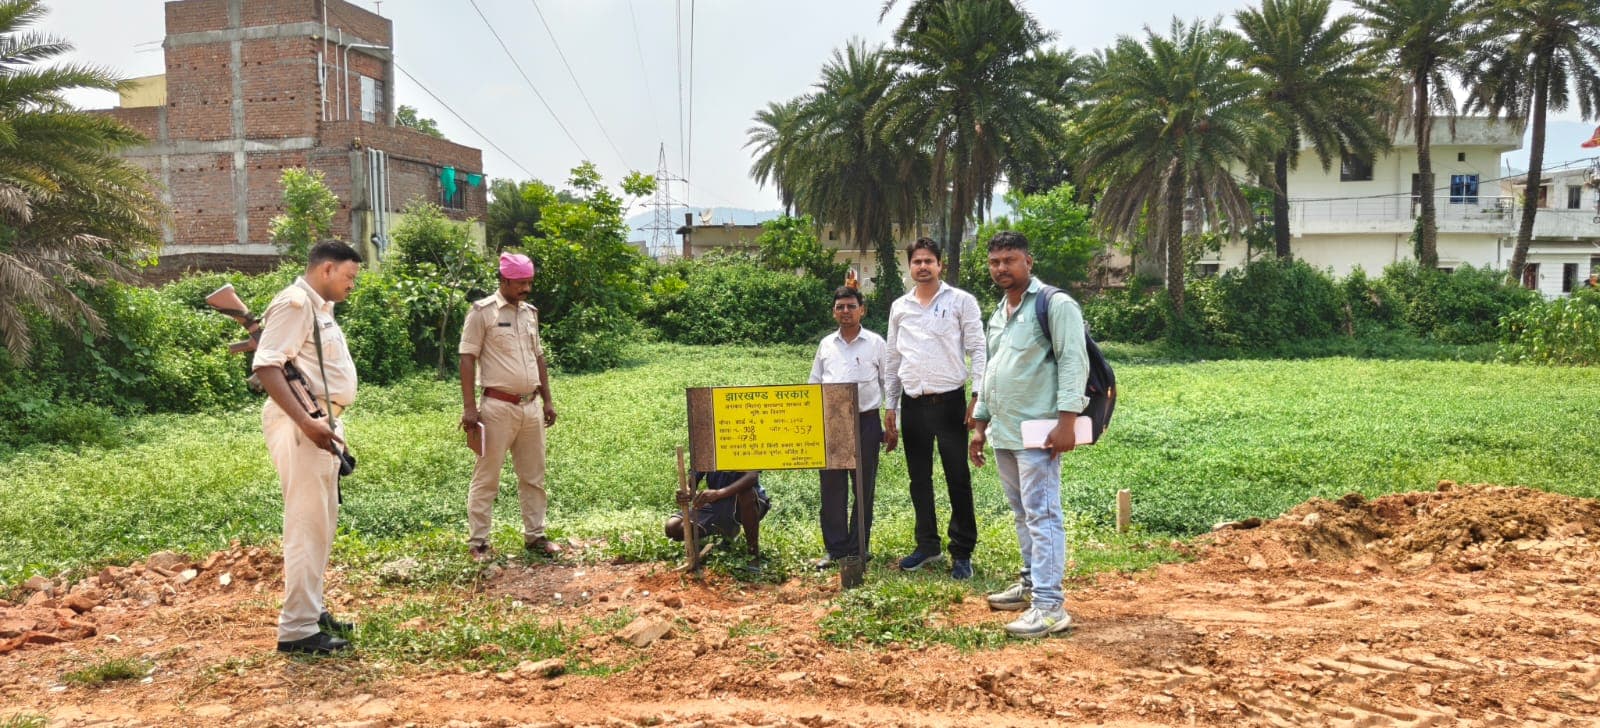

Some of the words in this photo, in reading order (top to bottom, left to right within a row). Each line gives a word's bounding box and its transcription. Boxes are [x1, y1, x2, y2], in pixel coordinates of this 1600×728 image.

[725, 391, 768, 402] झारखण्ड
[774, 390, 809, 400] सरकार
[794, 425, 812, 435] 357
